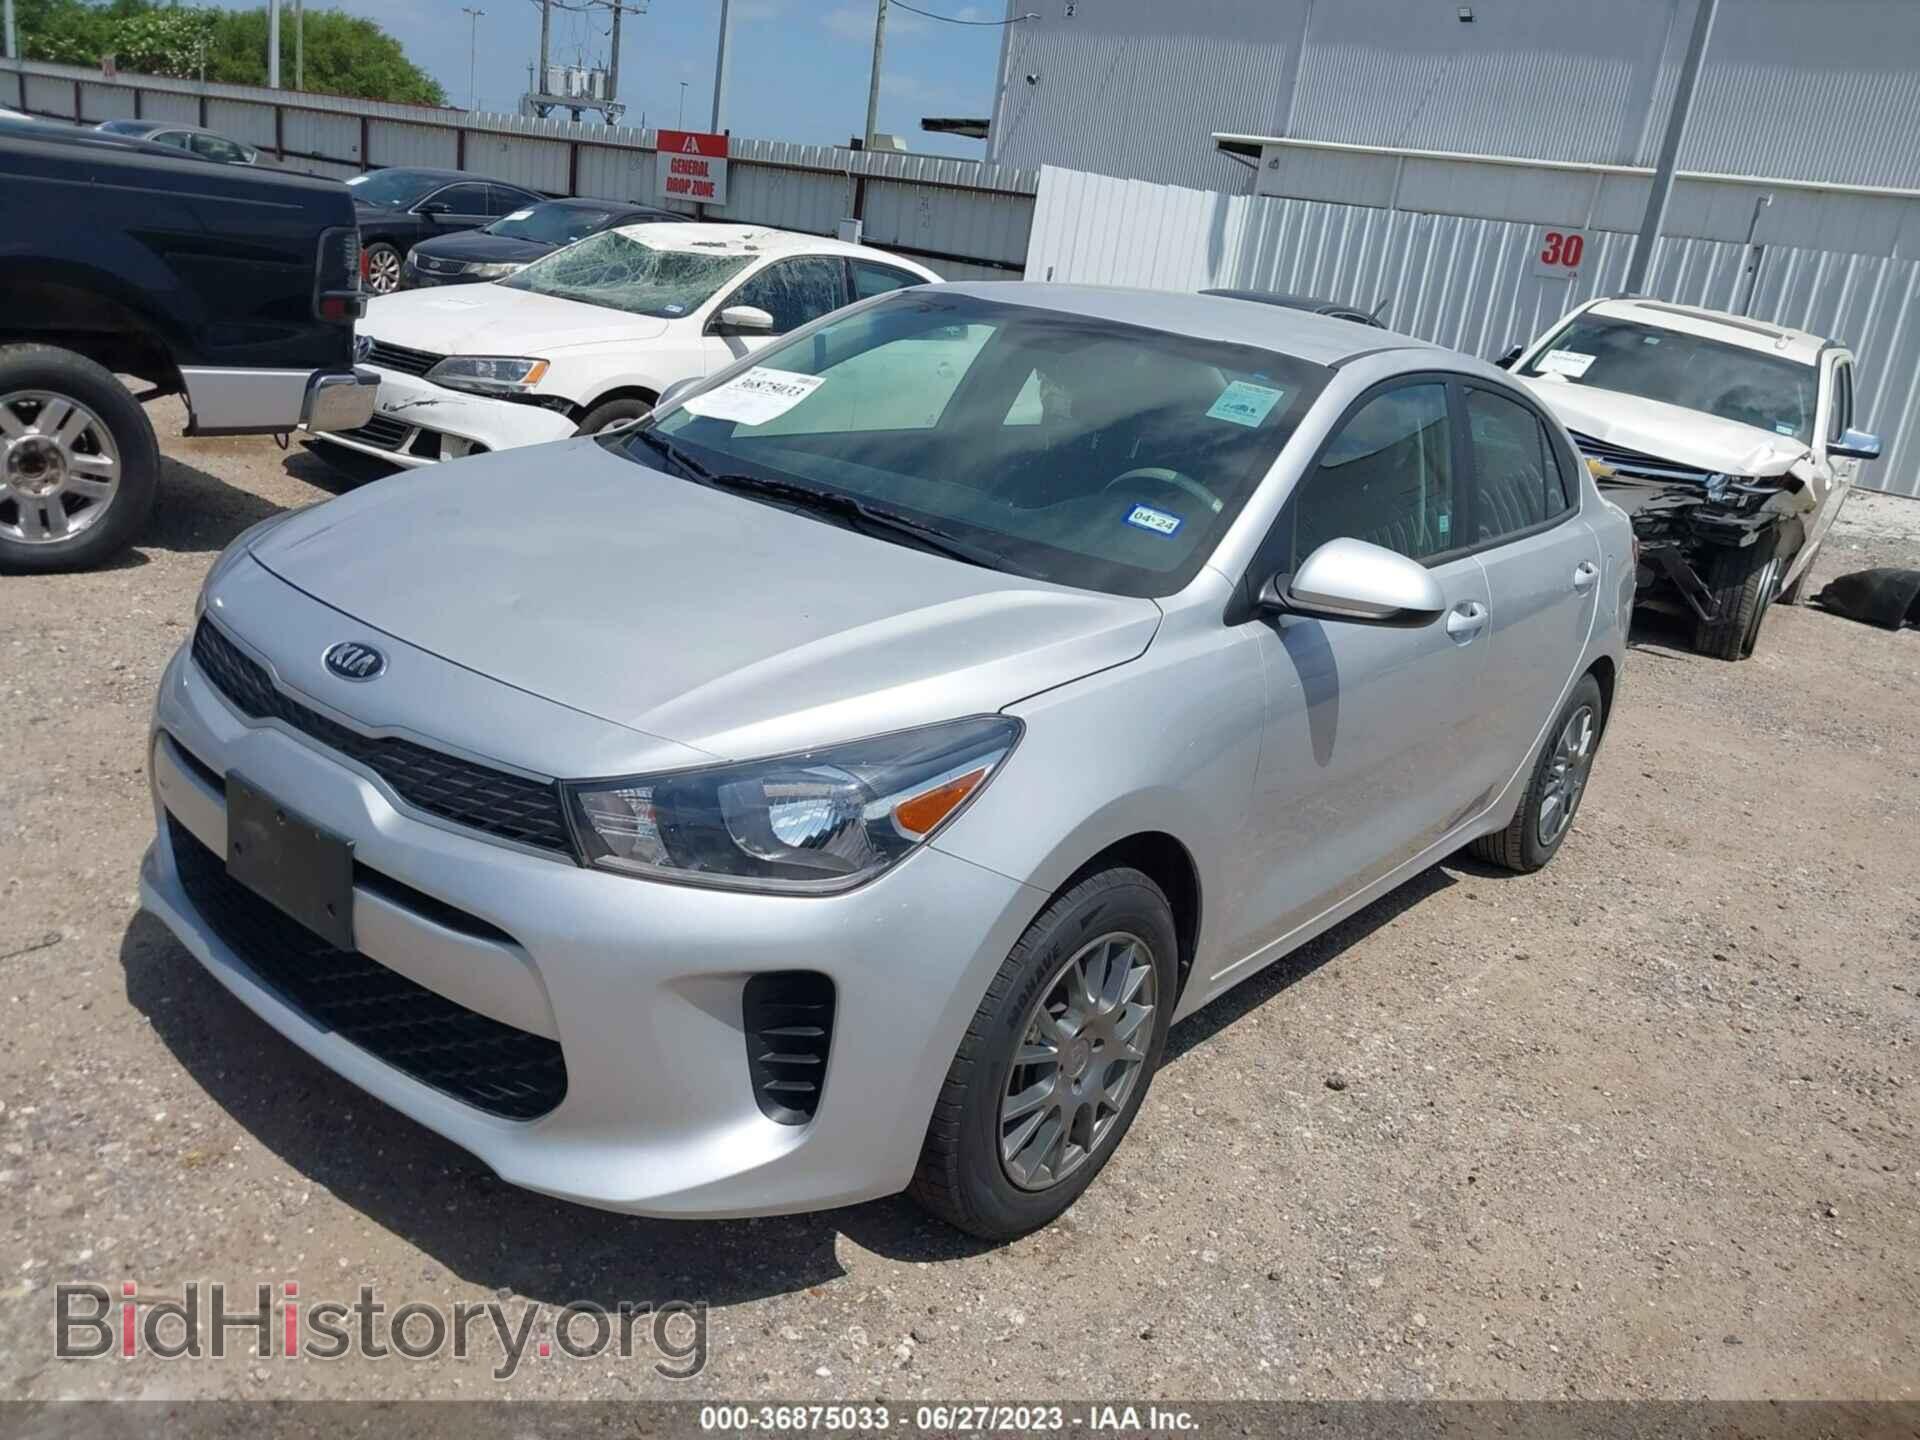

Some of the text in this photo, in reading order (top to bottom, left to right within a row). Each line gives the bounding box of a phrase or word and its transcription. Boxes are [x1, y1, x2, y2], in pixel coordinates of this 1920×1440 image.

[671, 157, 709, 178] GENERAL
[666, 176, 715, 198] DROP ZONE
[1541, 231, 1584, 268] 30
[329, 642, 376, 676] KIA
